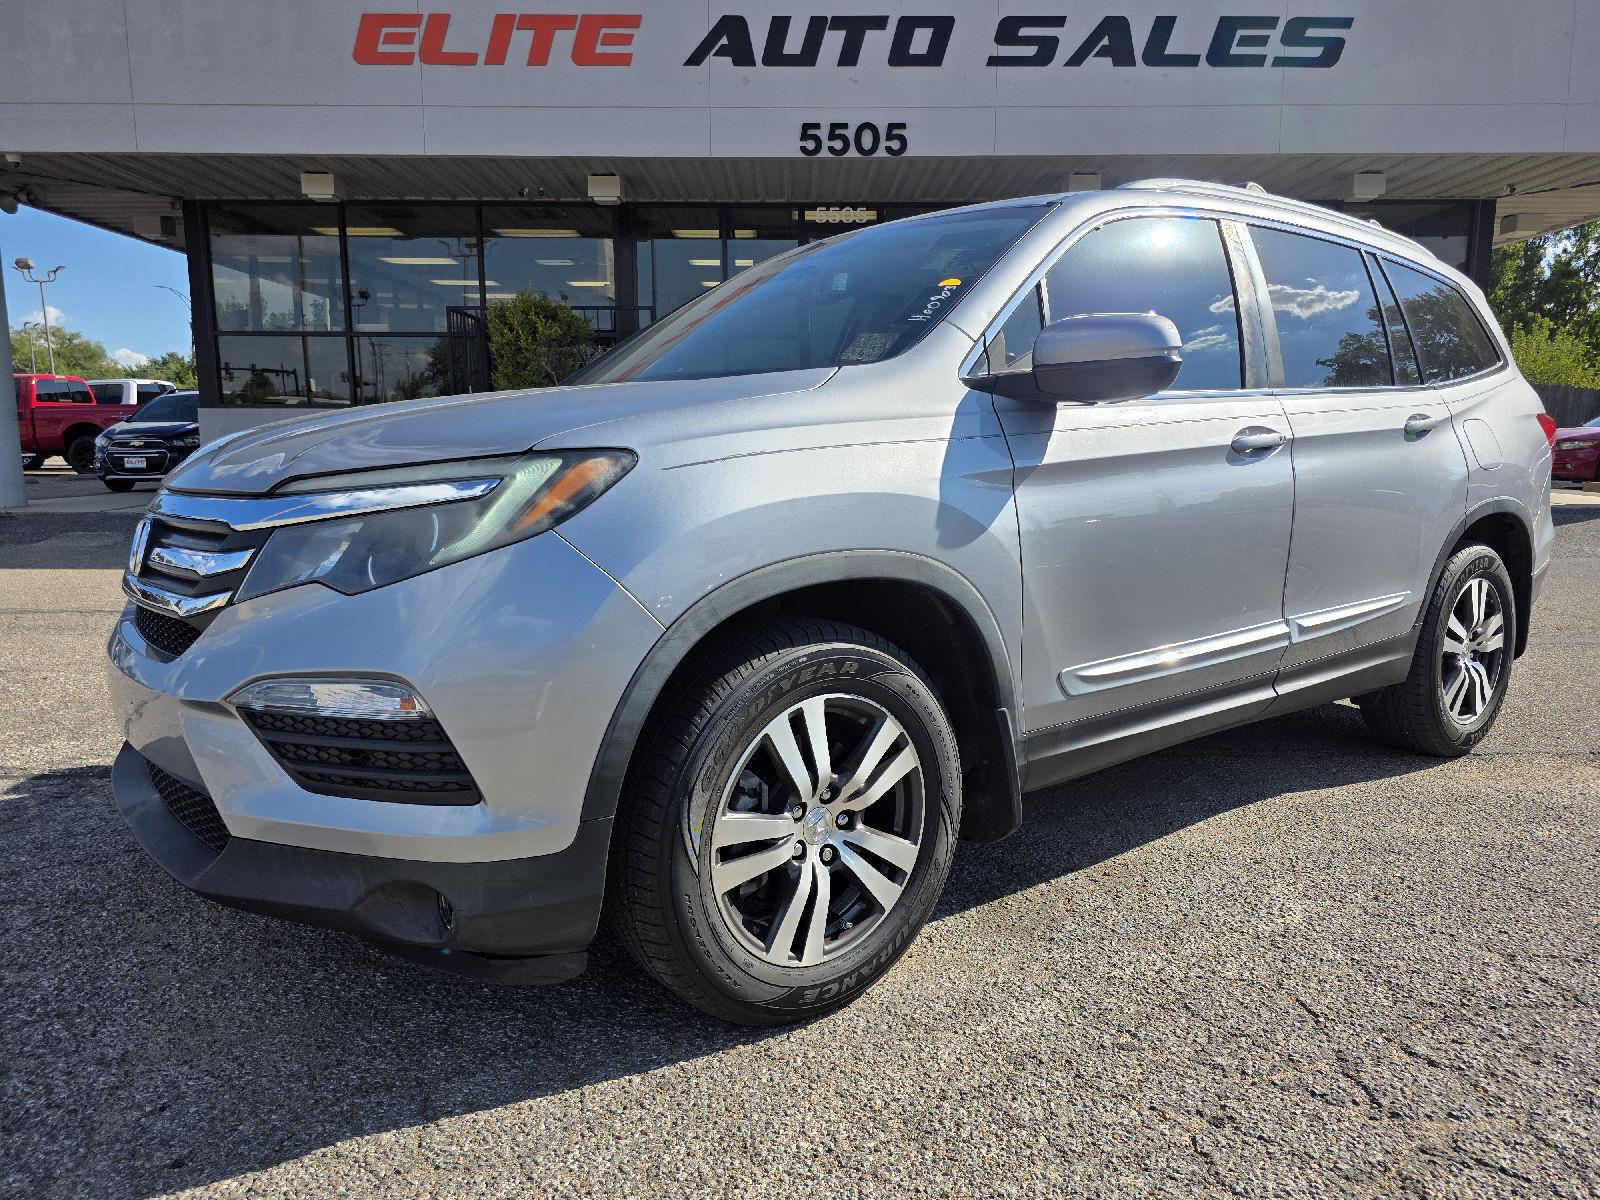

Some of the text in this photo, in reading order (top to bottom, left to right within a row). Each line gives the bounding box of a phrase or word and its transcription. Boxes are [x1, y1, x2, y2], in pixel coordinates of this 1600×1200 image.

[353, 13, 1355, 68] ELITE AUTO SALES
[799, 122, 908, 157] 5505
[815, 206, 868, 224] 5505
